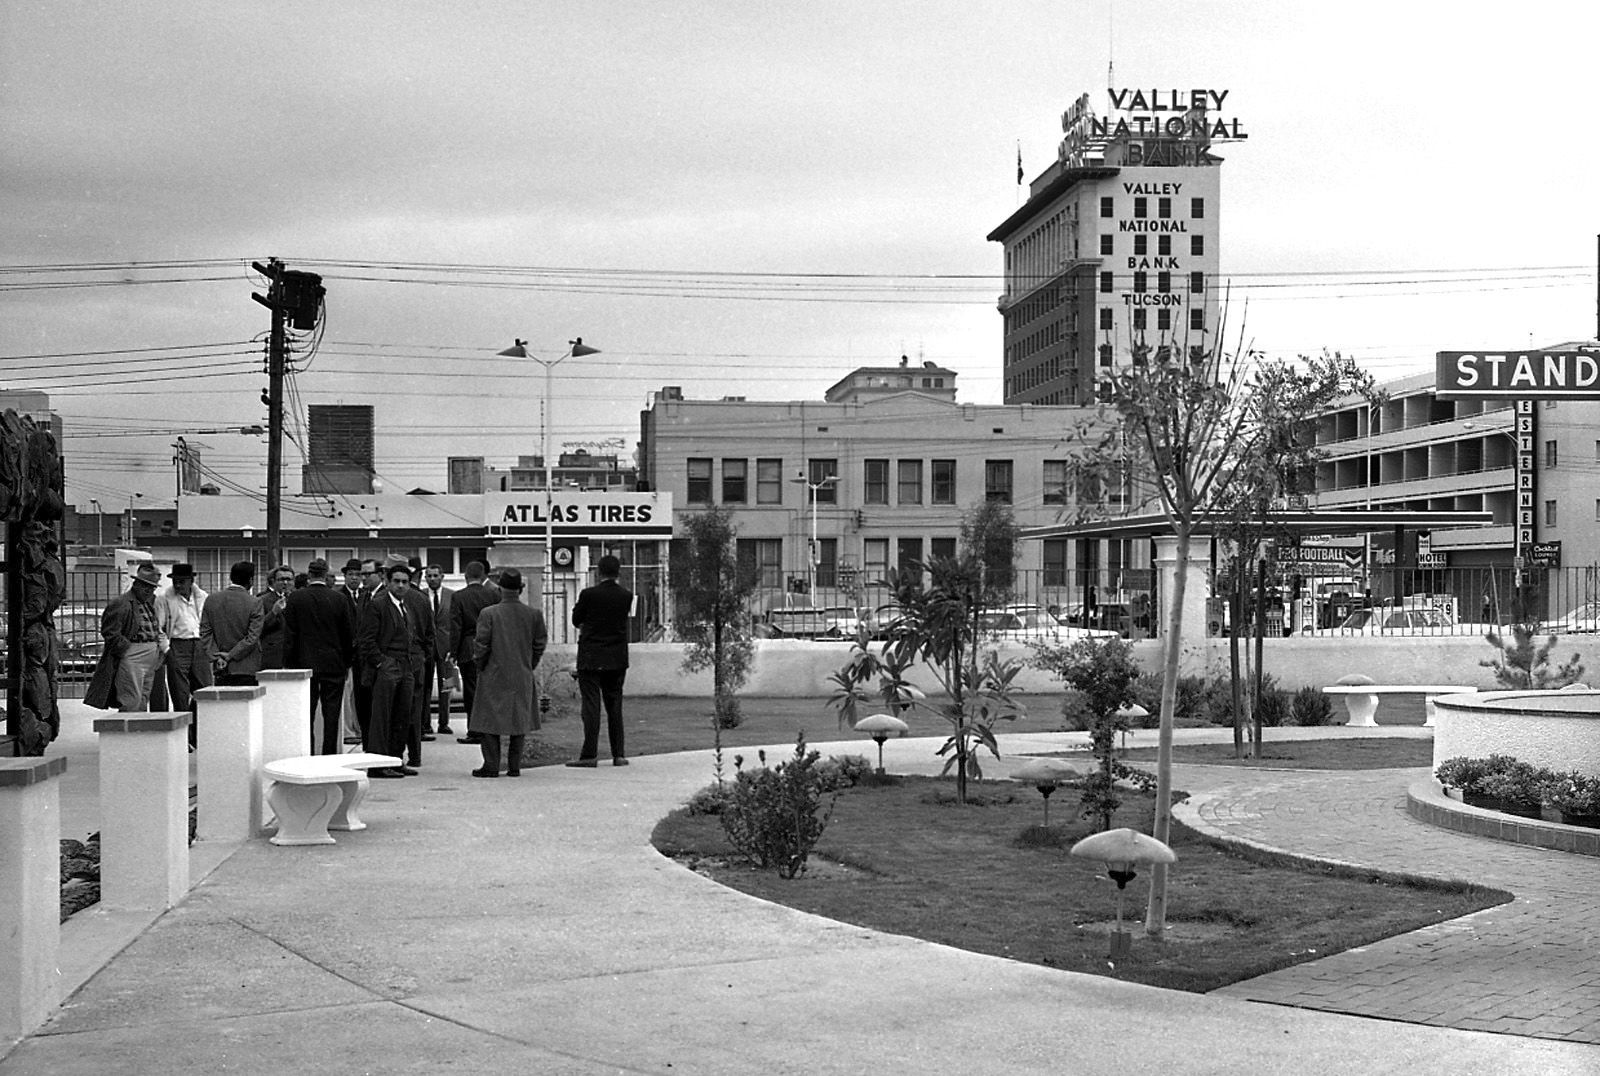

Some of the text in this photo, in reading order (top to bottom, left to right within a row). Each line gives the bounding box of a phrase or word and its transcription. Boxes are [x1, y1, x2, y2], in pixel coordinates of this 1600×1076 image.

[1108, 88, 1229, 111] VALLEY
[1092, 117, 1248, 139] NATIONAL
[1129, 144, 1212, 166] BANK
[1123, 183, 1182, 195] VALLEY
[1119, 220, 1187, 232] NATIONAL
[1128, 257, 1179, 269] BANK
[1122, 294, 1181, 306] TUCSON
[1457, 355, 1599, 387] STAND
[503, 505, 652, 523] ATLAS TIRES
[1300, 548, 1344, 561] FOOTBALL
